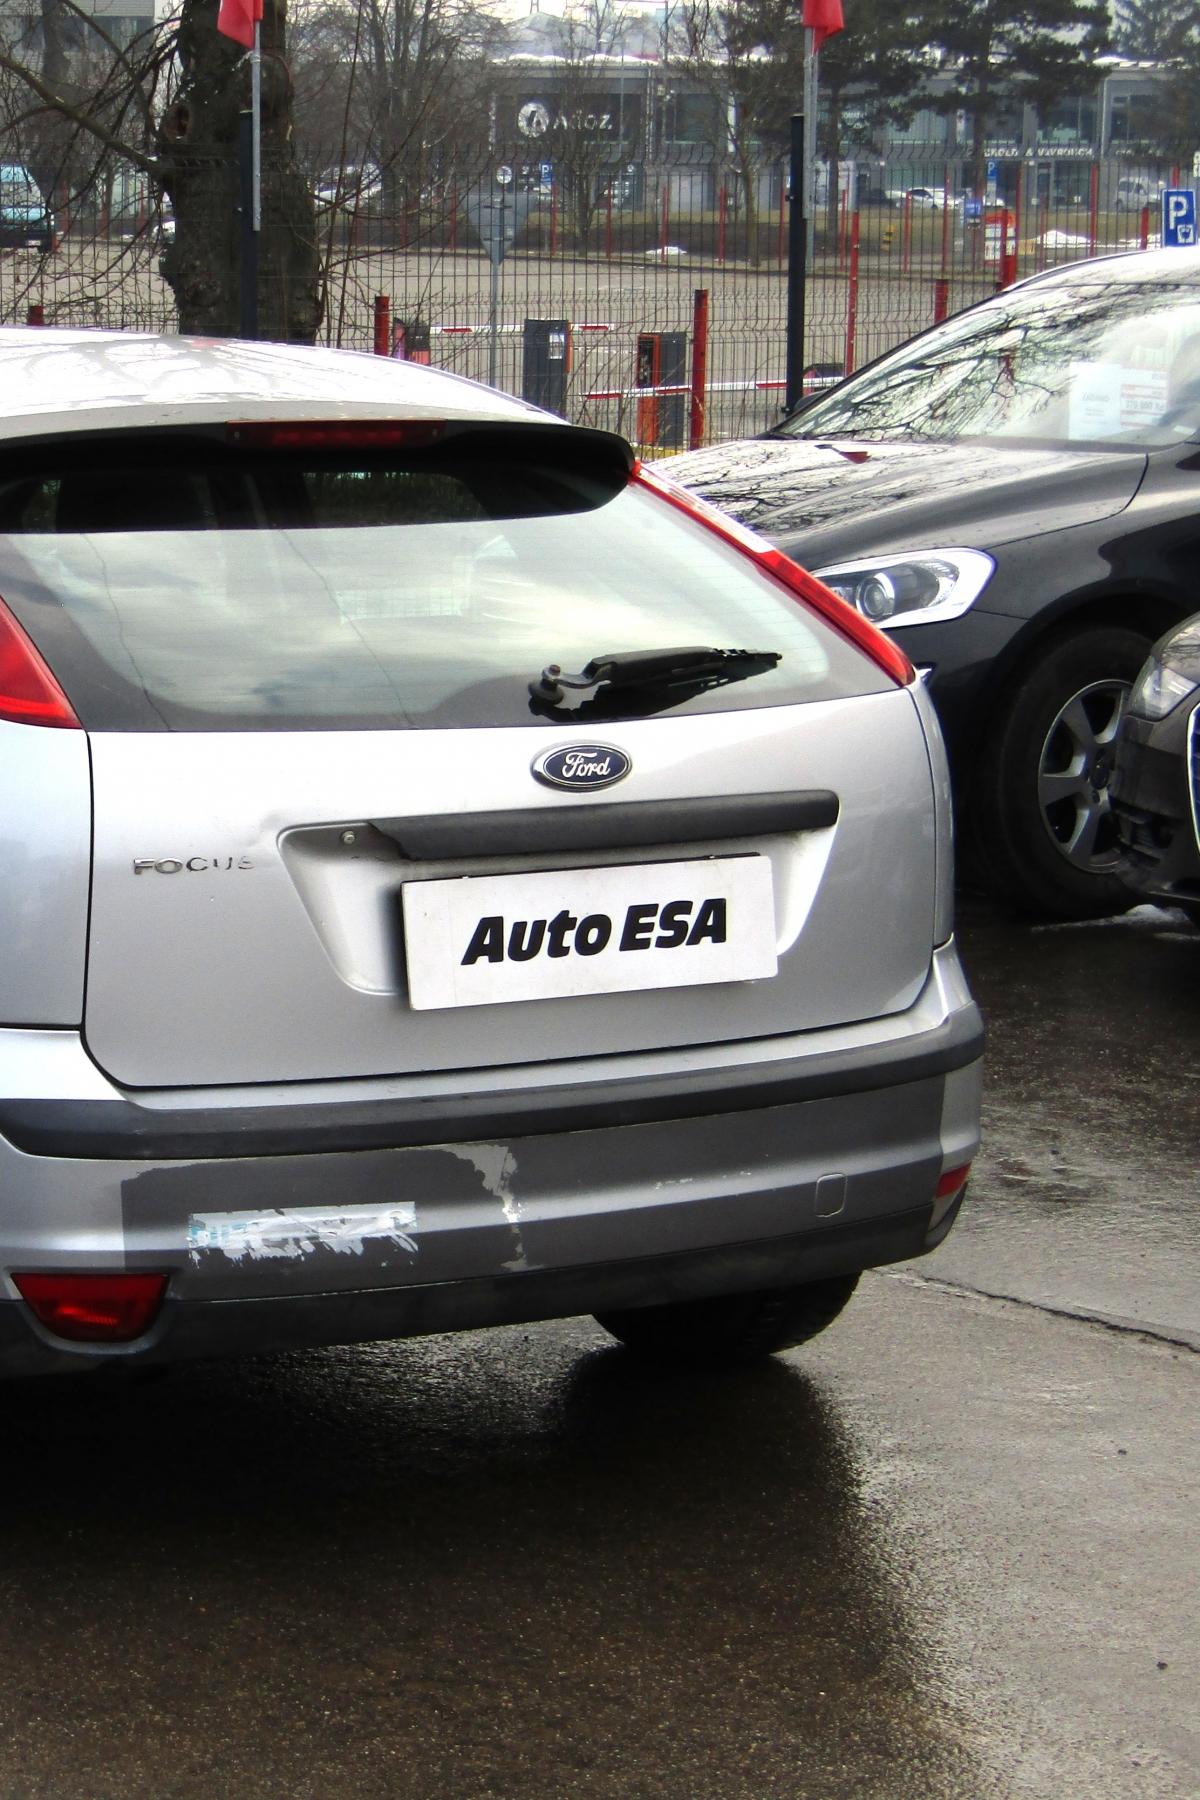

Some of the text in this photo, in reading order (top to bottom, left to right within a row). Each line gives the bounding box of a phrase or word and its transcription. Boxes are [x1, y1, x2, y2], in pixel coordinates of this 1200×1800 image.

[1168, 195, 1188, 230] P
[561, 752, 611, 778] Ford
[133, 856, 256, 875] FOCUS
[460, 897, 727, 966] Auto ESA
